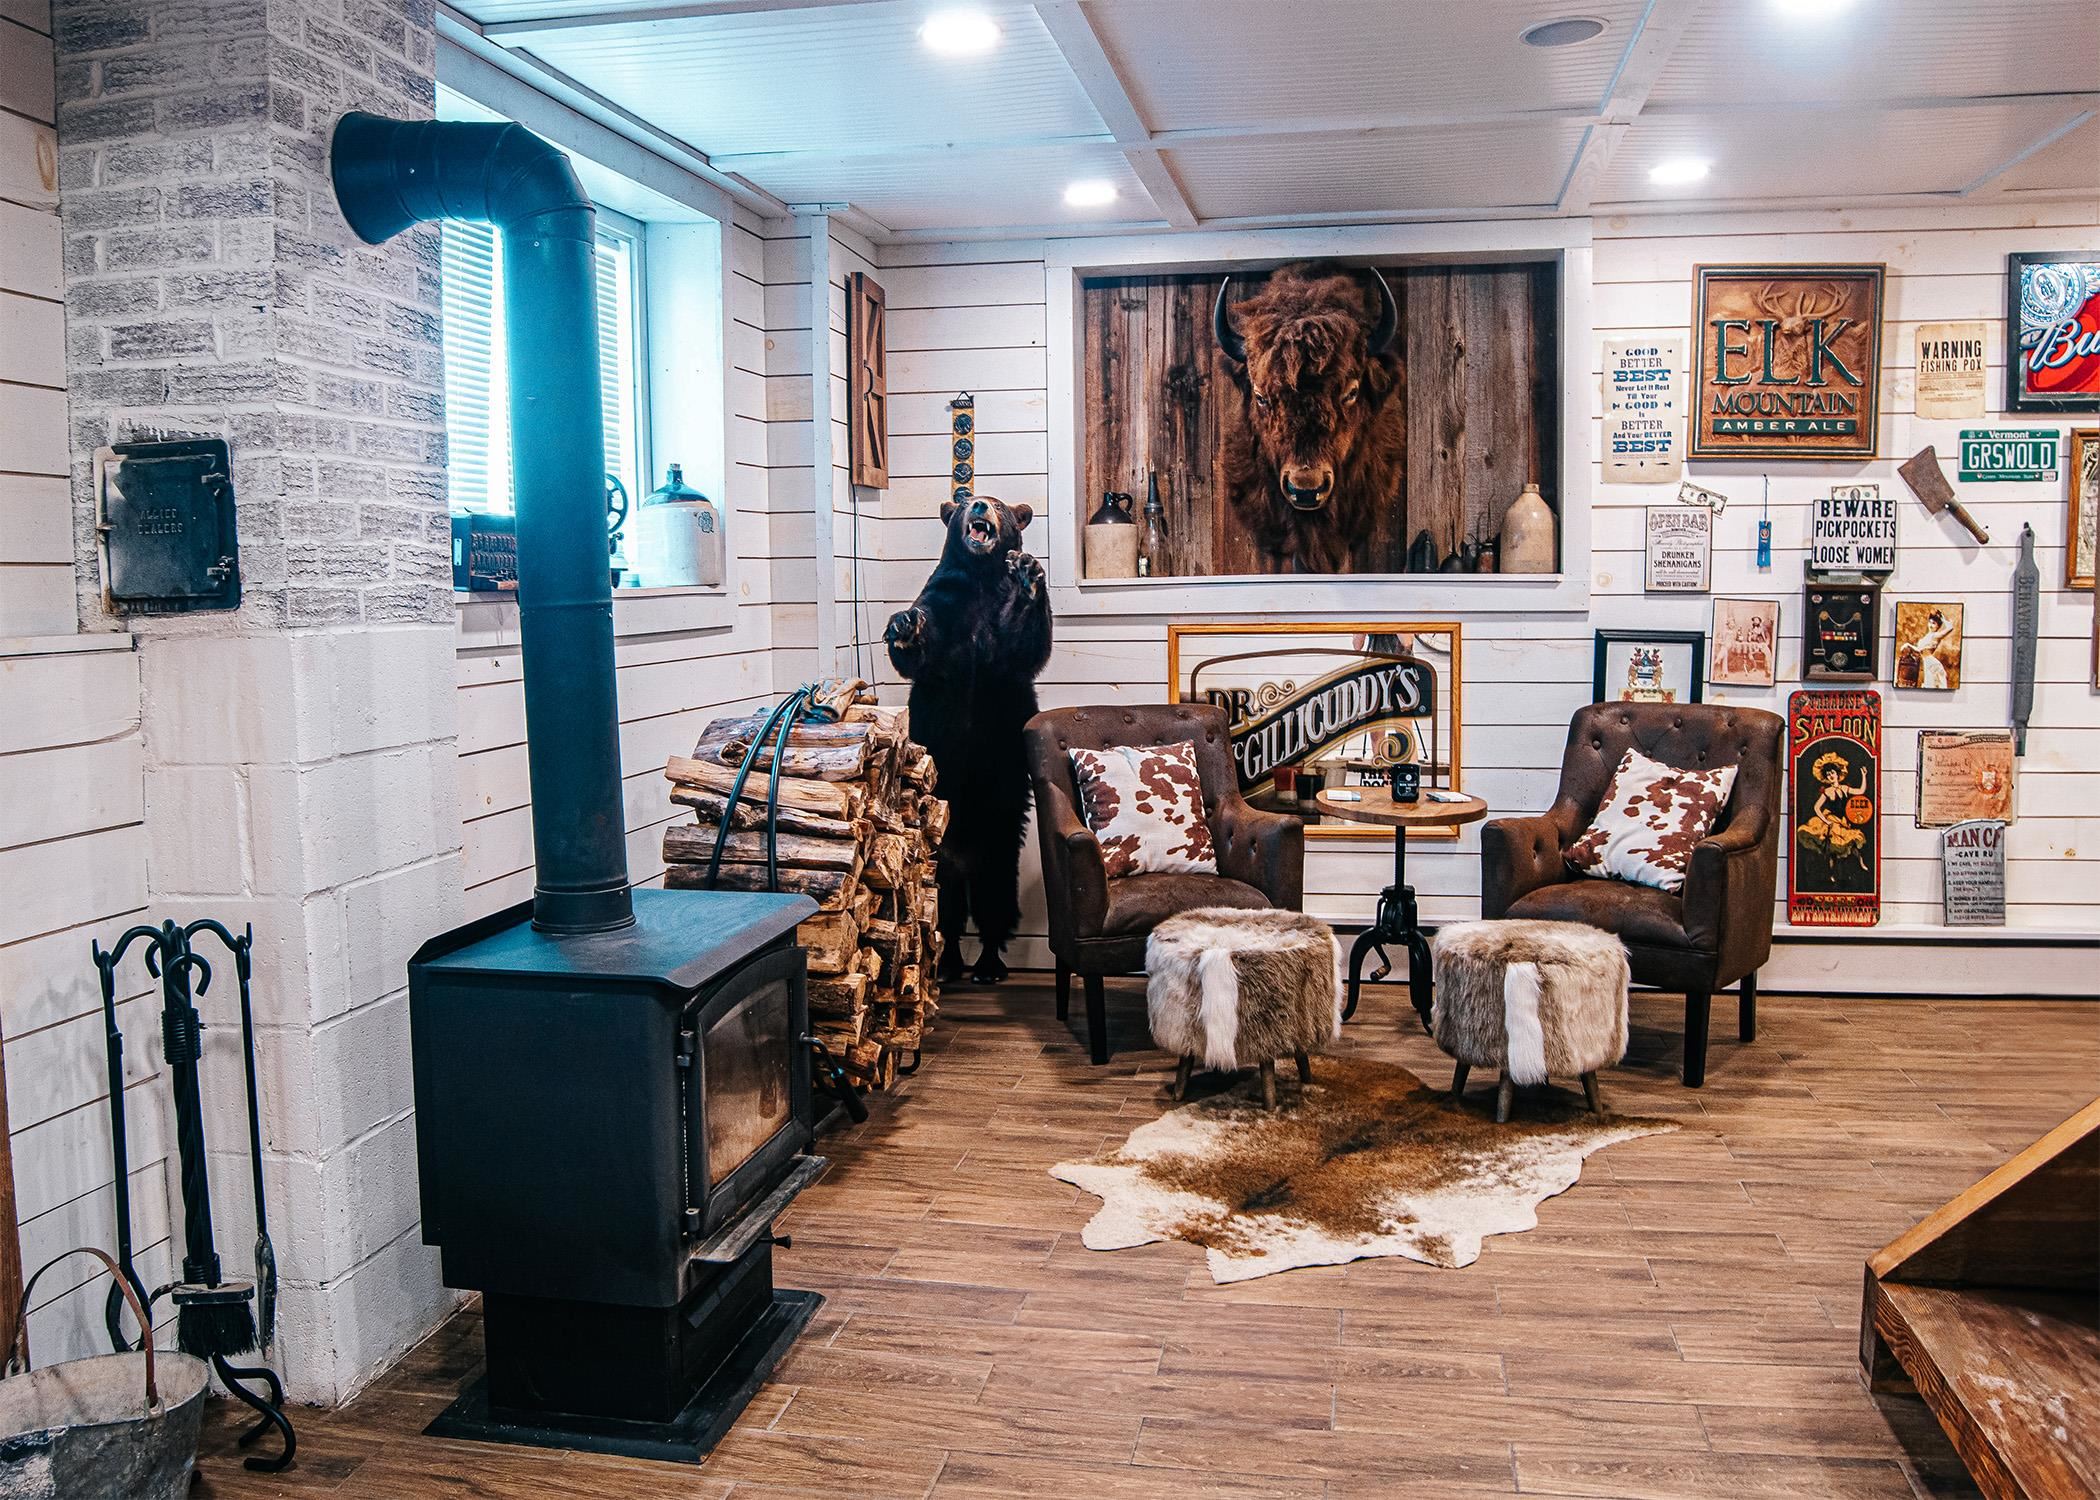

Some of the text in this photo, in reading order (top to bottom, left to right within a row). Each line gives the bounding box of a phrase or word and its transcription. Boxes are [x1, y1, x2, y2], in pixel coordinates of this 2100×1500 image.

[1625, 347, 1659, 357] GOOD
[1711, 318, 1864, 387] ELK
[1921, 340, 1982, 359] WARNING
[1620, 357, 1663, 369] BETTER
[1920, 358, 1982, 373] FISHING POX
[1613, 369, 1672, 383] BEST
[1625, 401, 1659, 410] GOOD
[1710, 391, 1858, 416] MOUNTAIN
[1621, 420, 1664, 431] BETTER
[1722, 421, 1847, 432] AMBER ALE
[1989, 430, 2030, 439] Vermont
[1612, 439, 1672, 453] BEST
[1968, 443, 2052, 469] GRSWOLD
[1820, 500, 1894, 518] BEWARE
[1649, 513, 1709, 533] OPEN BAR
[1815, 520, 1896, 538] PICKPOCKETS
[1661, 551, 1695, 559] DRUNKEN
[1813, 545, 1895, 564] LOOSE WOMEN
[1653, 560, 1702, 568] SHENANIGANS
[1794, 714, 1879, 749] SALOON
[1947, 827, 1980, 848] MAN
